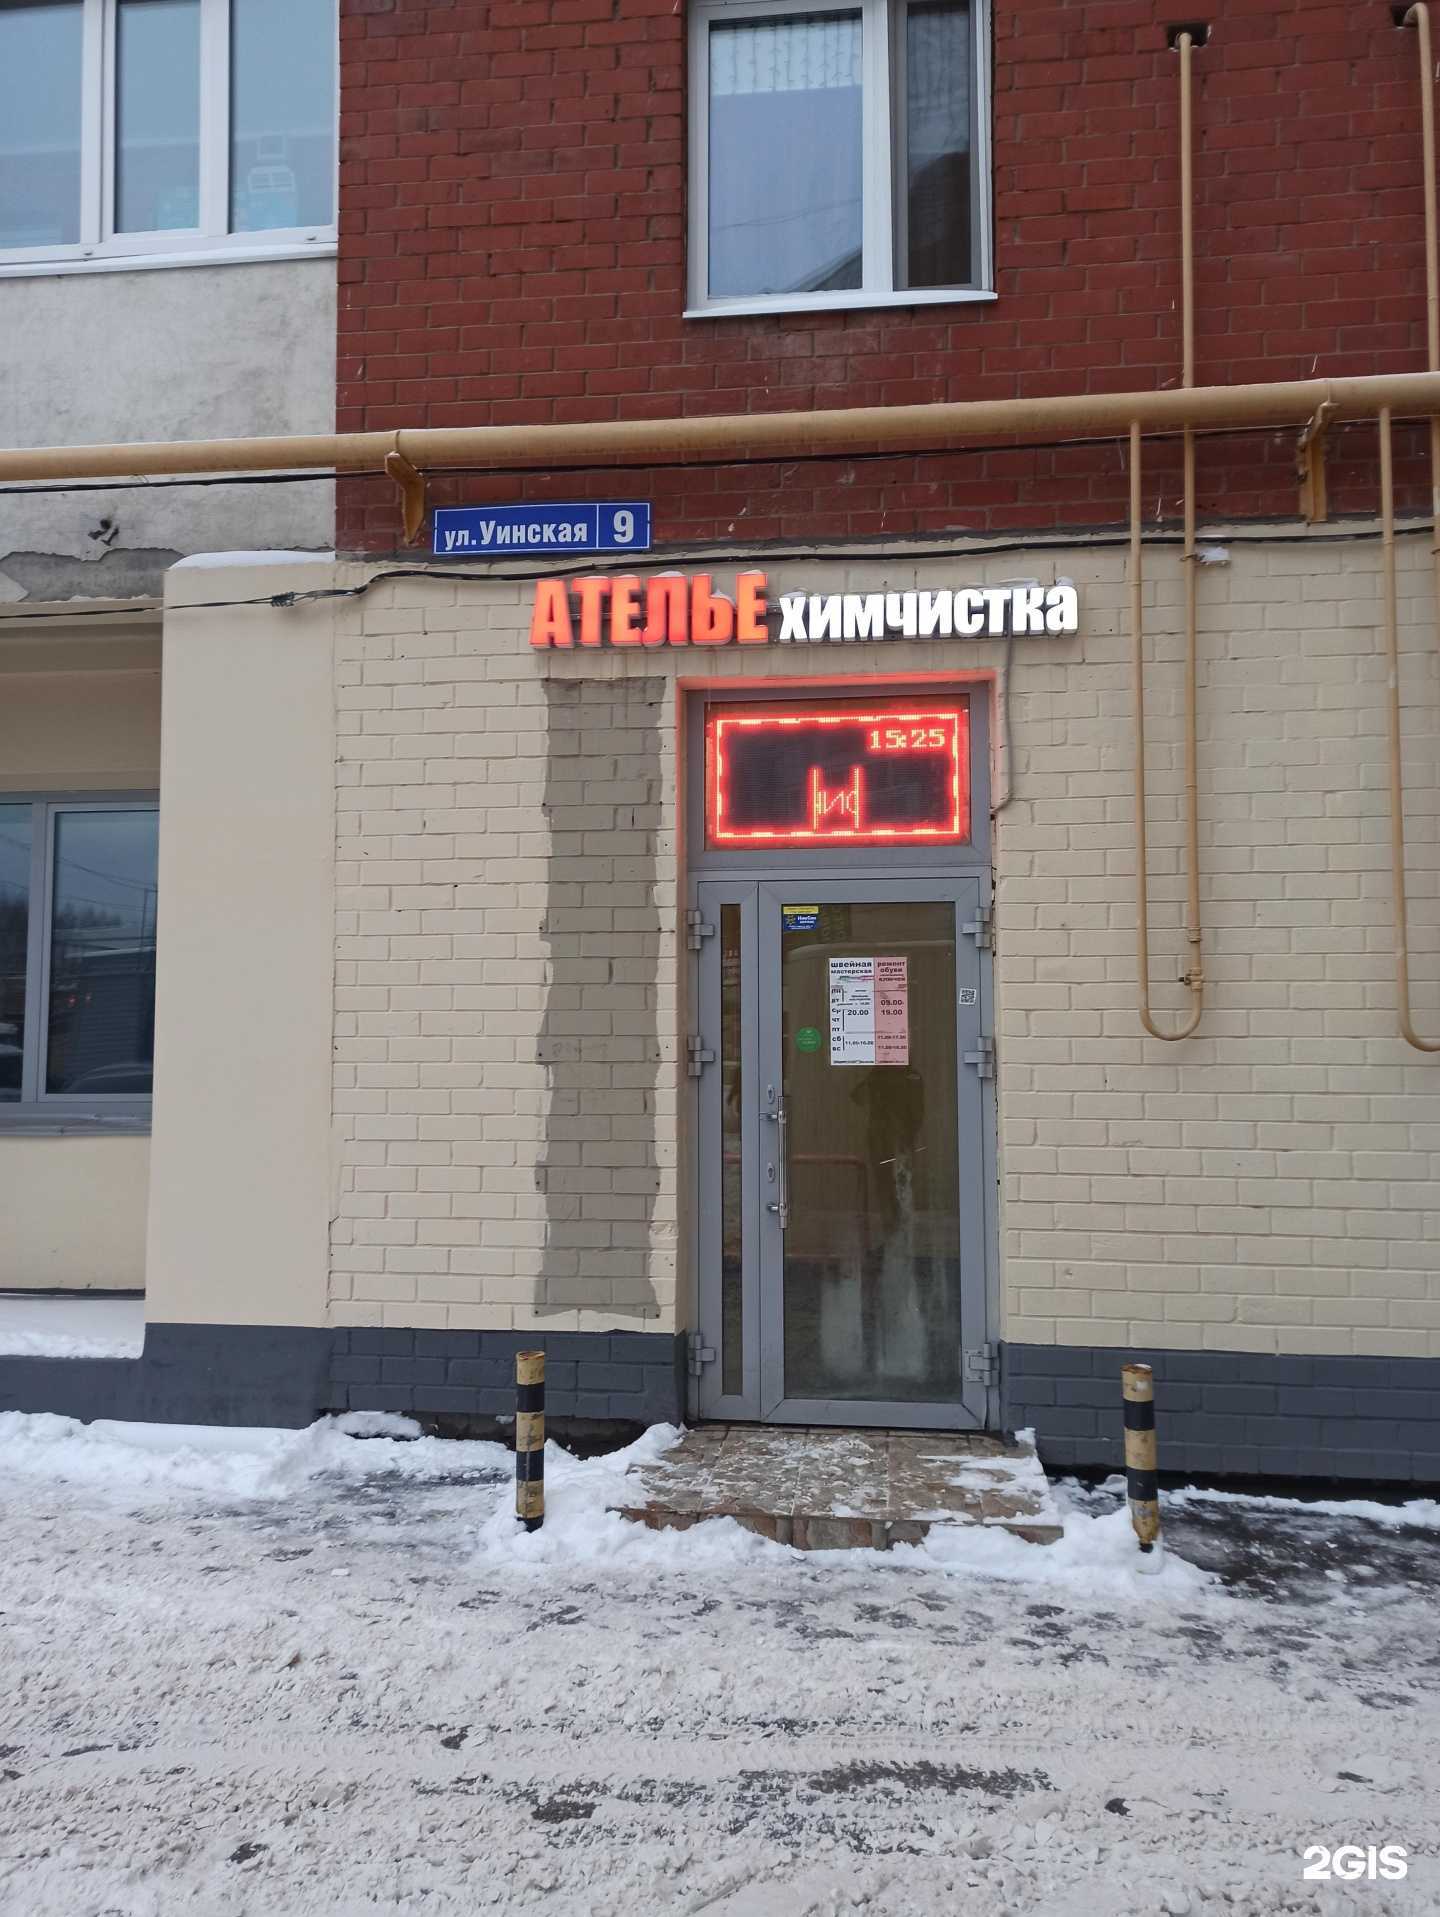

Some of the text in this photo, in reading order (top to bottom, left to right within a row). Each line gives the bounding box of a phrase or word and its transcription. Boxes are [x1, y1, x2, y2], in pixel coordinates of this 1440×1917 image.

[445, 510, 634, 551] ул. Уинская 9
[530, 572, 1079, 650] АТЕЛЬЕ химчистка
[870, 728, 945, 749] 15:25
